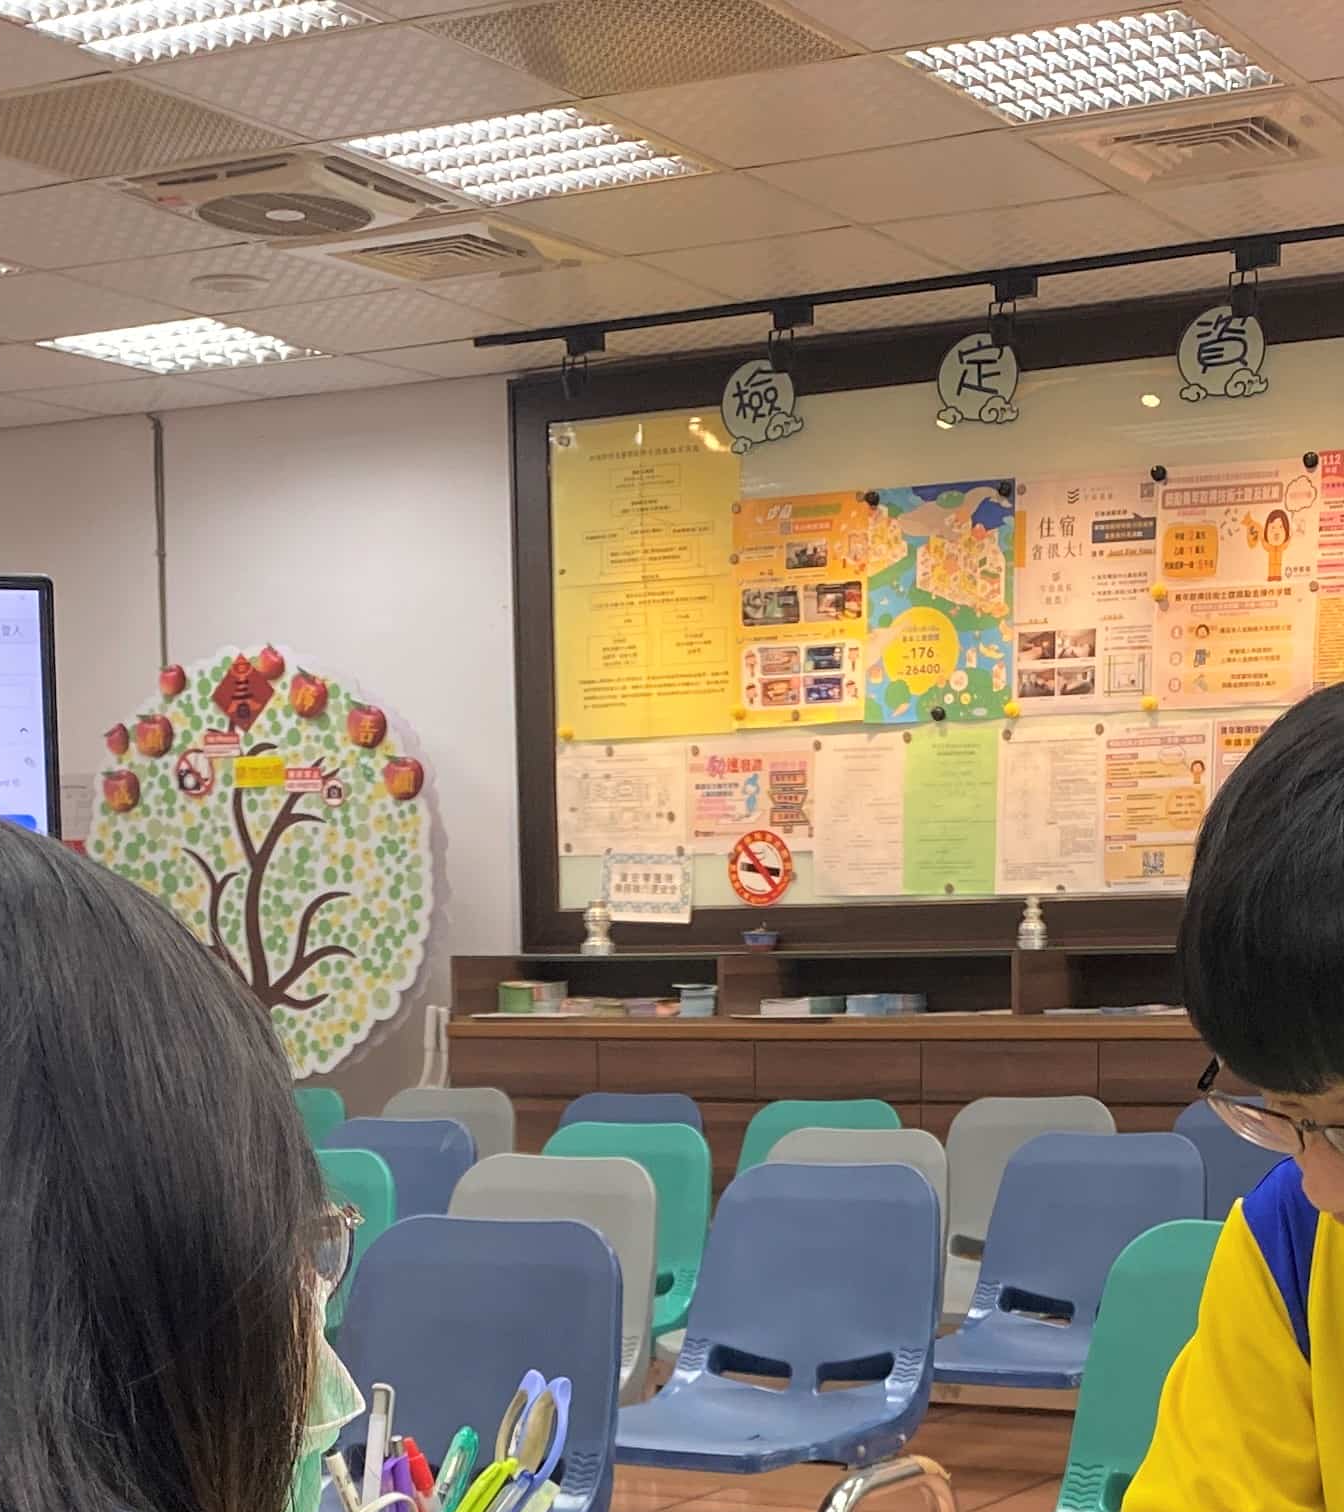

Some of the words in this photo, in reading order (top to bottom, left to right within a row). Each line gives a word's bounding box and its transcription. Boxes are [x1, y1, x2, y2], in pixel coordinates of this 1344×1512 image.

[954, 338, 1005, 397] 定
[1195, 314, 1249, 375] 資
[1322, 453, 1342, 465] 112
[1039, 515, 1076, 539] 住宿
[1032, 541, 1083, 561] 省很大!
[912, 647, 934, 658] 176
[905, 664, 941, 675] 26400
